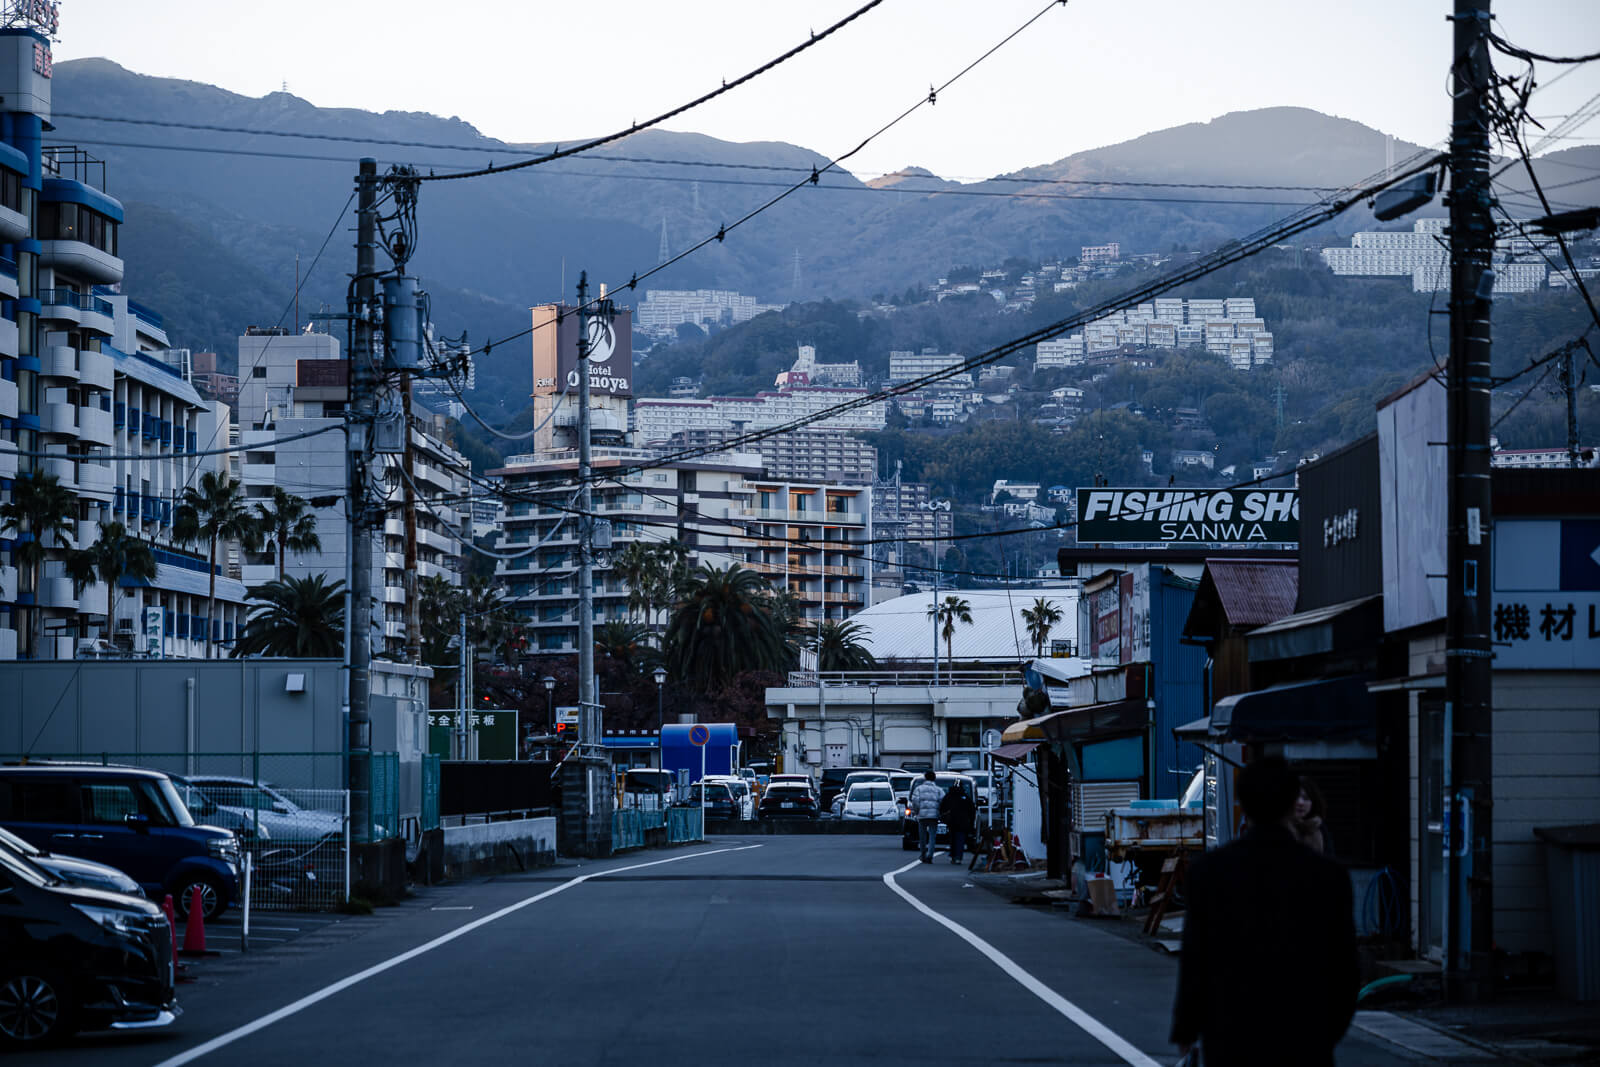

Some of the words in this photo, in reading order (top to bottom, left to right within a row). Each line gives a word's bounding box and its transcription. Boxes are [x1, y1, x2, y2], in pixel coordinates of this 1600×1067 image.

[567, 370, 629, 393] Onoya
[1084, 491, 1233, 521] FISHING
[1160, 523, 1267, 540] SANWA
[556, 722, 566, 733] P
